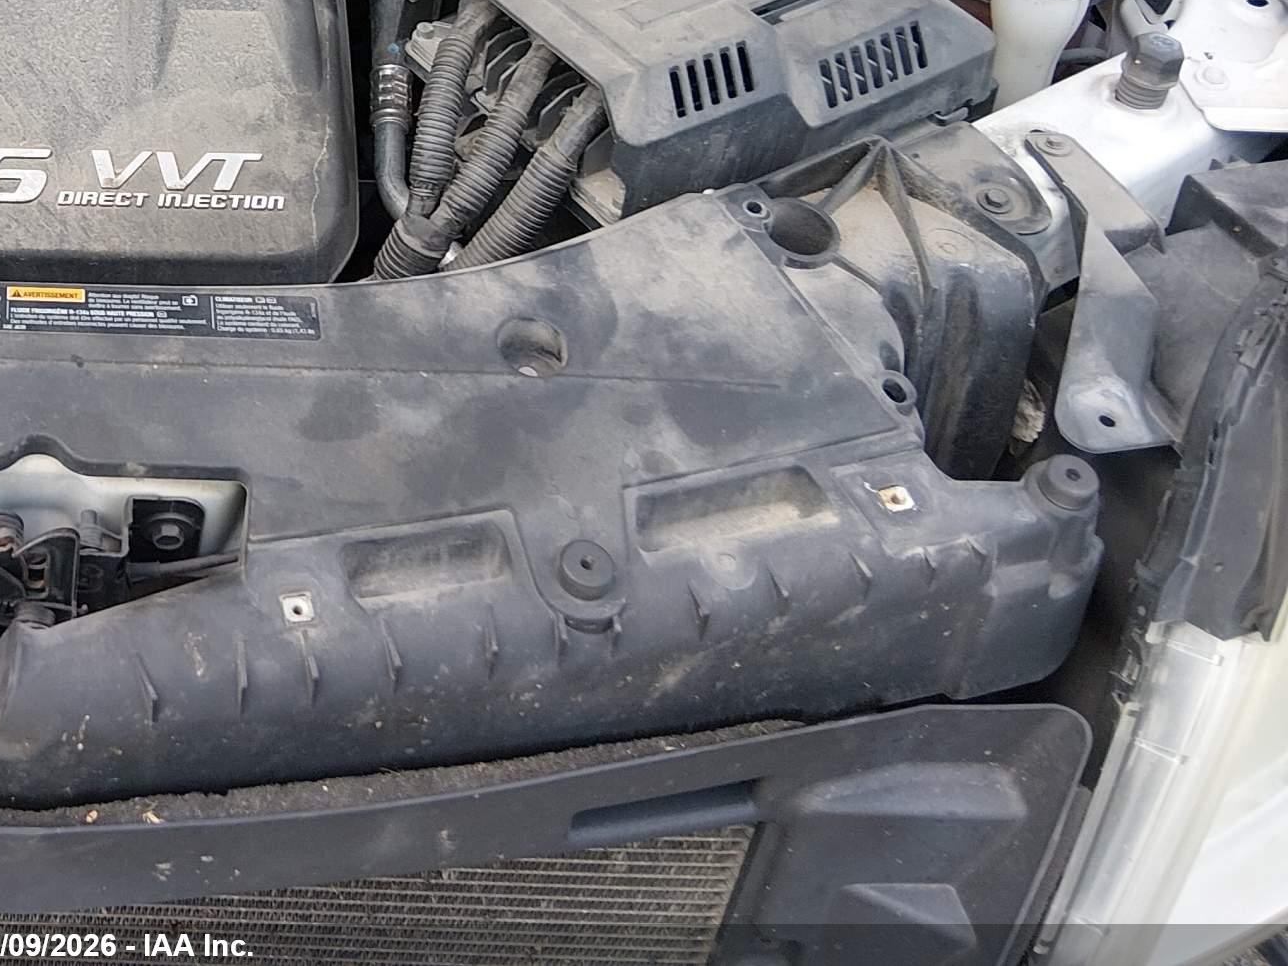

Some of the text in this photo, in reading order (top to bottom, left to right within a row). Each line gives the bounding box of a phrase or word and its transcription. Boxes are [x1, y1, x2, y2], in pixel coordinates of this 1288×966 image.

[91, 149, 264, 191] VVT
[57, 190, 285, 210] DIRECT INJECTION
[23, 291, 79, 299] AVERTISSEMENT
